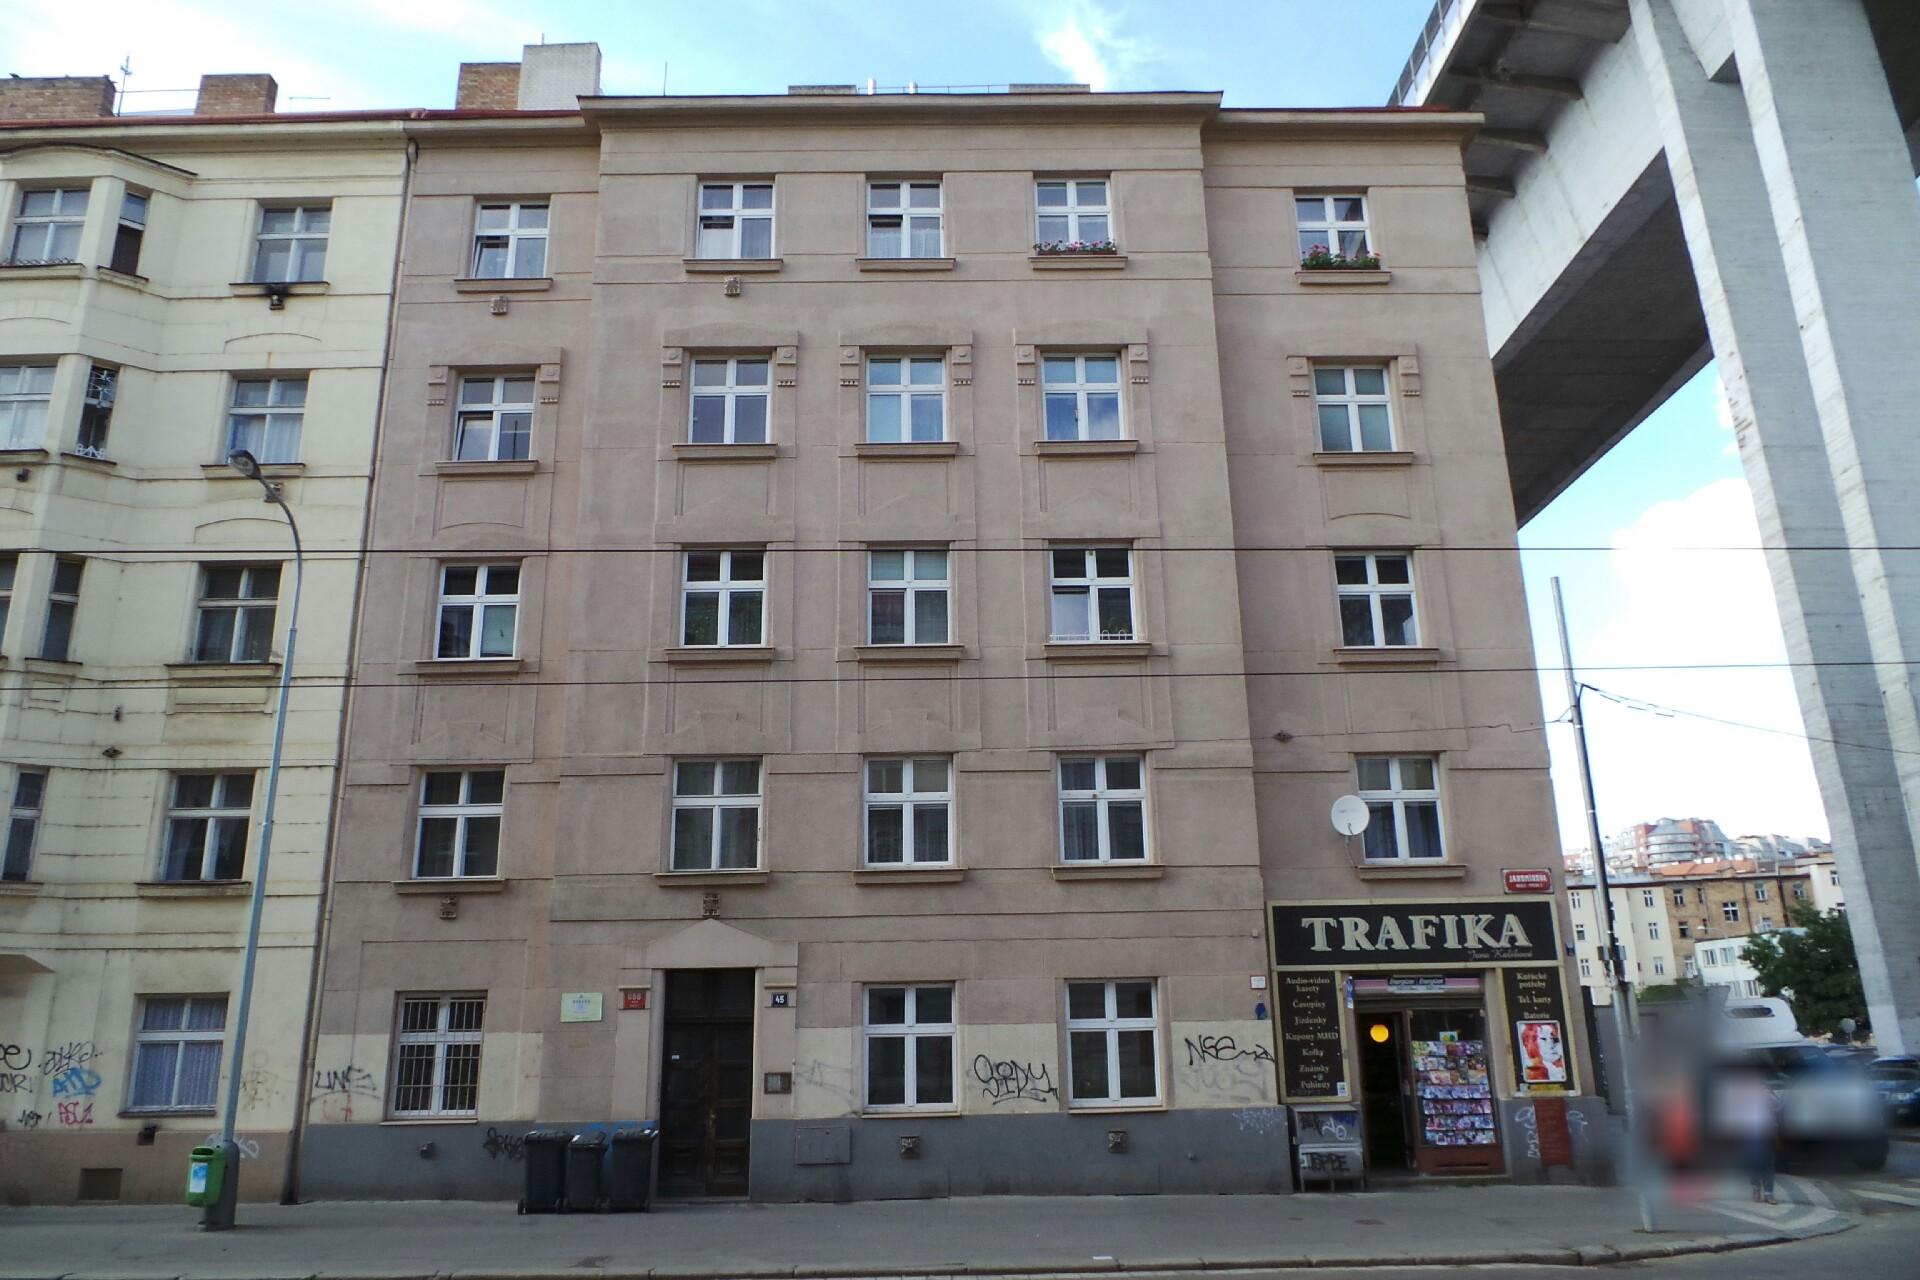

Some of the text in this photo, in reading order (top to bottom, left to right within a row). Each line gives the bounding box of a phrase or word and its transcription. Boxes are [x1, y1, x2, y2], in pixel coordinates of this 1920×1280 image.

[1301, 914, 1533, 952] TRAFIKA
[1285, 977, 1331, 985] Audio-video
[775, 994, 785, 1004] 45
